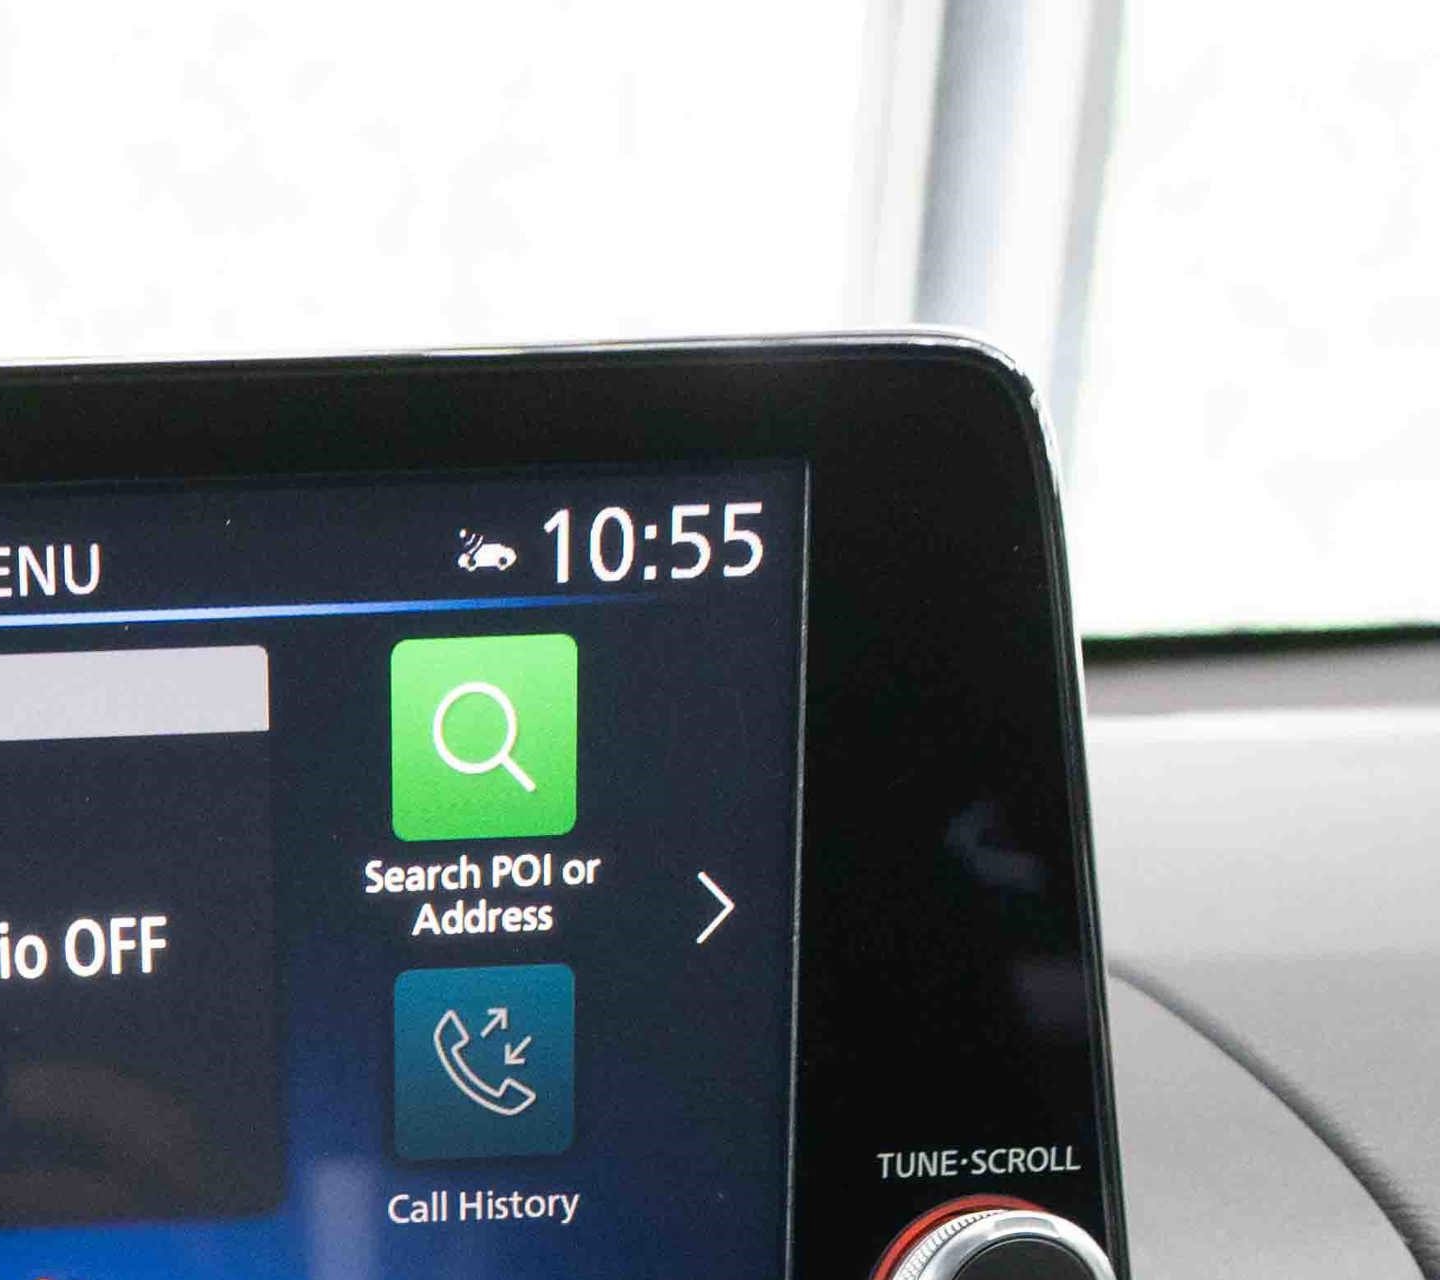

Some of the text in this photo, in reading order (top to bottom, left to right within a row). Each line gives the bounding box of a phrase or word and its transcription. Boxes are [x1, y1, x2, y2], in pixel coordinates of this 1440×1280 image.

[543, 501, 764, 584] 10:55
[365, 853, 602, 894] Search POI or
[411, 898, 553, 936] Address
[64, 915, 167, 978] OFF
[387, 1190, 580, 1224] Call History
